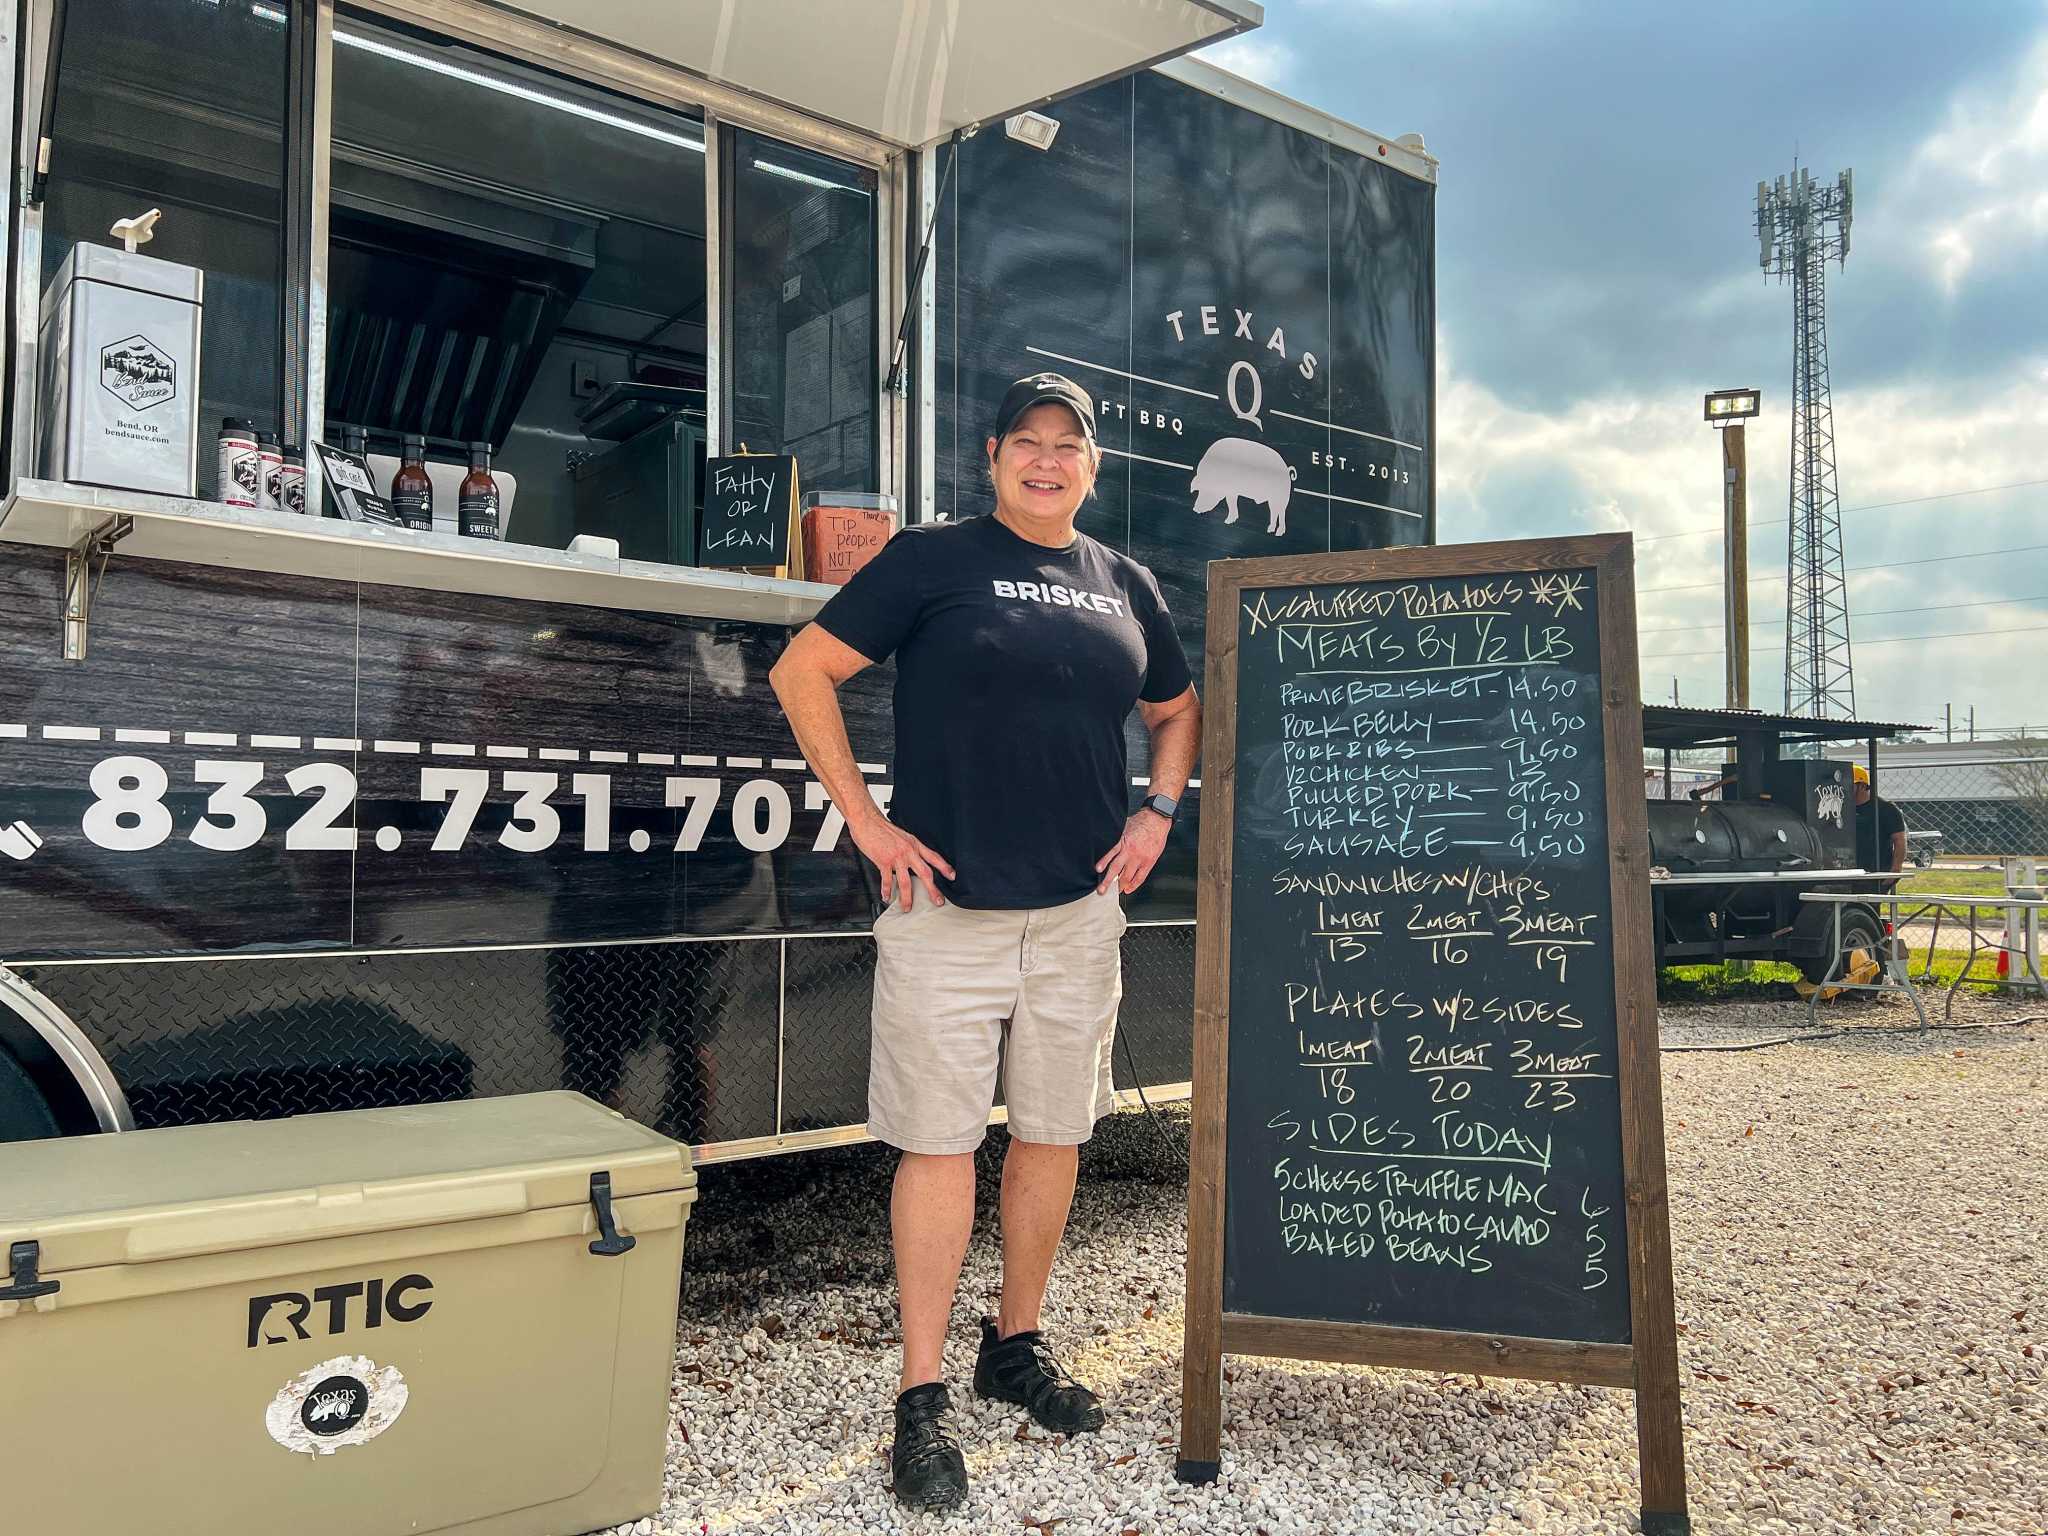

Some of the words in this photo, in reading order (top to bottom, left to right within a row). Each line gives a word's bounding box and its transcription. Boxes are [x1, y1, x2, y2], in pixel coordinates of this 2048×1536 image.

[1166, 305, 1318, 380] TEXAS
[1227, 360, 1264, 432] Q
[105, 428, 169, 444] bendsauce.com
[143, 425, 158, 433] OR
[1140, 410, 1183, 435] BBQ
[1312, 451, 1355, 472] EST.
[1368, 463, 1410, 485] 2013
[727, 500, 757, 517] OR
[469, 524, 493, 535] SWEET
[706, 522, 774, 553] LEAN
[837, 533, 878, 550] people
[828, 551, 854, 569] NOT
[992, 580, 1124, 618] BRISKET
[1278, 625, 1404, 669] MEATS
[1525, 626, 1574, 661] LB
[1508, 675, 1577, 702] 14.50
[1281, 713, 1350, 739] PORK
[1510, 708, 1585, 736] 14.50
[1283, 741, 1342, 763] PORK
[1346, 739, 1416, 760] RIBS
[1500, 736, 1578, 763] 9.50
[1287, 785, 1384, 807] PULLED
[1392, 782, 1472, 809] PORK
[1508, 780, 1581, 805] 9.50
[1283, 803, 1414, 839] TURKEY
[1507, 804, 1584, 832] 9.50
[1284, 827, 1448, 858] SAUSAGE
[1509, 831, 1585, 858] 9.50
[1330, 937, 1367, 962] 13
[1432, 940, 1469, 964] 16
[1536, 945, 1567, 983] 19
[1284, 983, 1425, 1022] PLATES
[1483, 997, 1584, 1028] SIDES
[1320, 1066, 1356, 1104] 18
[1428, 1075, 1472, 1103] 20
[1524, 1081, 1577, 1112] 23
[1267, 1109, 1416, 1149] SIDES
[1432, 1109, 1552, 1174] TODAY
[1378, 1163, 1481, 1202] TRUFFLE
[1487, 1171, 1557, 1216] MAC
[1279, 1196, 1371, 1228] LOADED
[1585, 1224, 1606, 1259] 5
[1281, 1223, 1376, 1258] BAKED
[1386, 1237, 1493, 1274] BEANS
[1582, 1257, 1608, 1290] 5
[247, 1273, 434, 1349] RTIC
[309, 1389, 357, 1410] Texas
